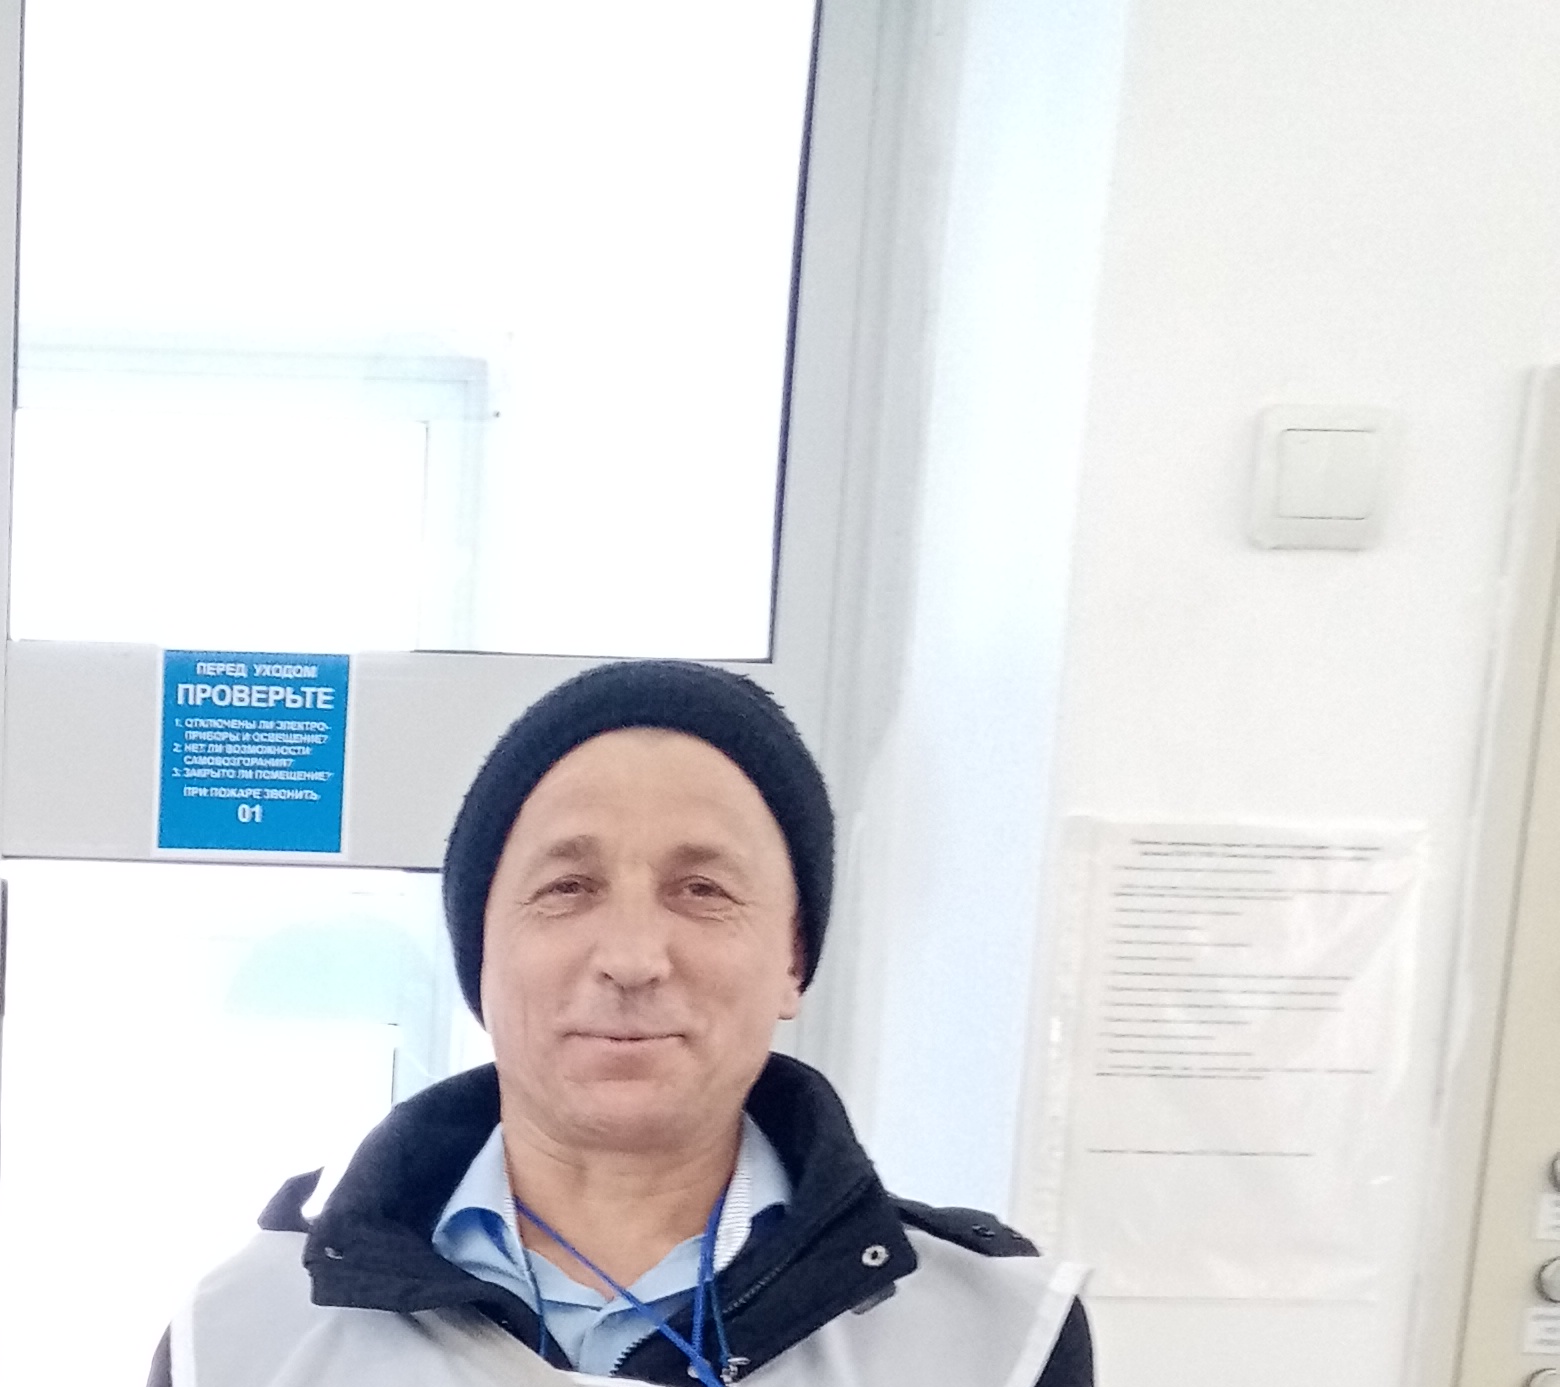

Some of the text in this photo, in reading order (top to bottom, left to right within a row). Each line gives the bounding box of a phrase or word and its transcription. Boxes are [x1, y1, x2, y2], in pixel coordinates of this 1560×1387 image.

[196, 662, 318, 679] ПЕРЕД УХОДОМ
[177, 683, 336, 710] ПРОВЕРЬТЕ
[210, 787, 262, 799] ПОЖАРЕ
[237, 803, 264, 823] 01
